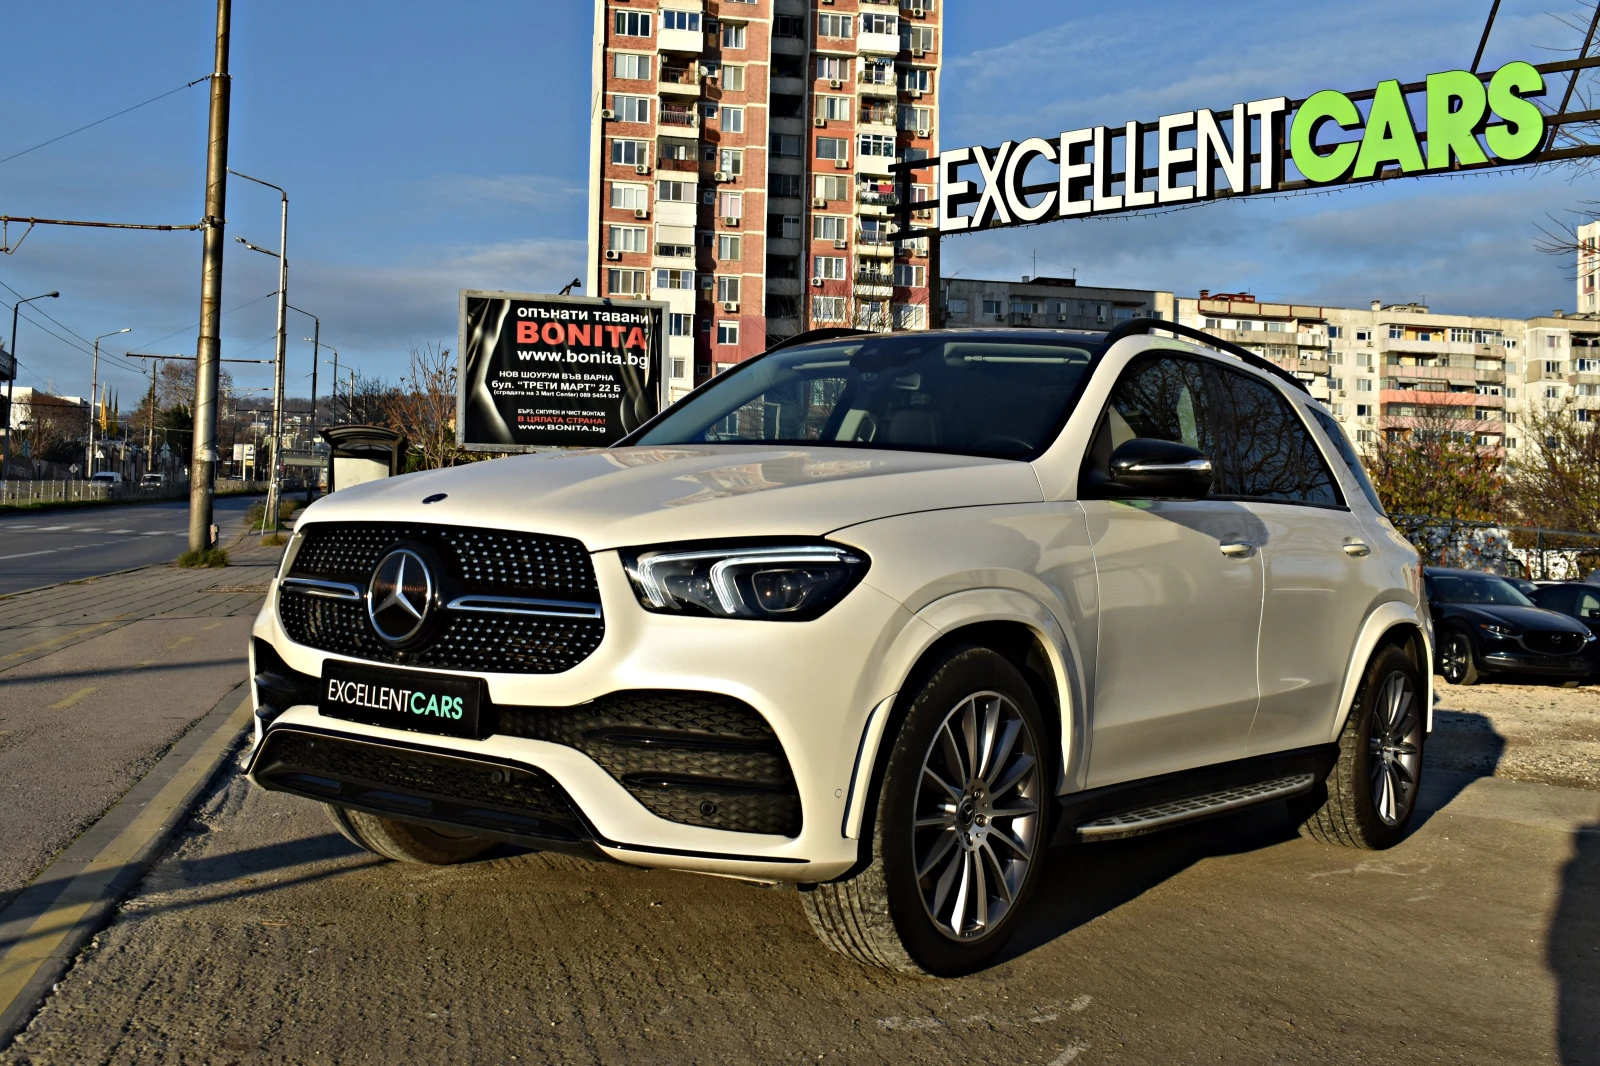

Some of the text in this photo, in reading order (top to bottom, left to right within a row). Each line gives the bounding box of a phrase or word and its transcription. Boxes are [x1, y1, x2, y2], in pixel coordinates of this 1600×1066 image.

[517, 307, 648, 325] опънати тавани
[516, 321, 648, 349] BONITA
[517, 349, 648, 369] www.bonita.bg
[499, 370, 519, 378] НОВ
[520, 371, 560, 379] ШОУРУМ
[491, 380, 514, 390] бул.
[598, 384, 611, 392] 22
[613, 384, 621, 392] Б
[518, 424, 606, 433] www.BONITA.bg
